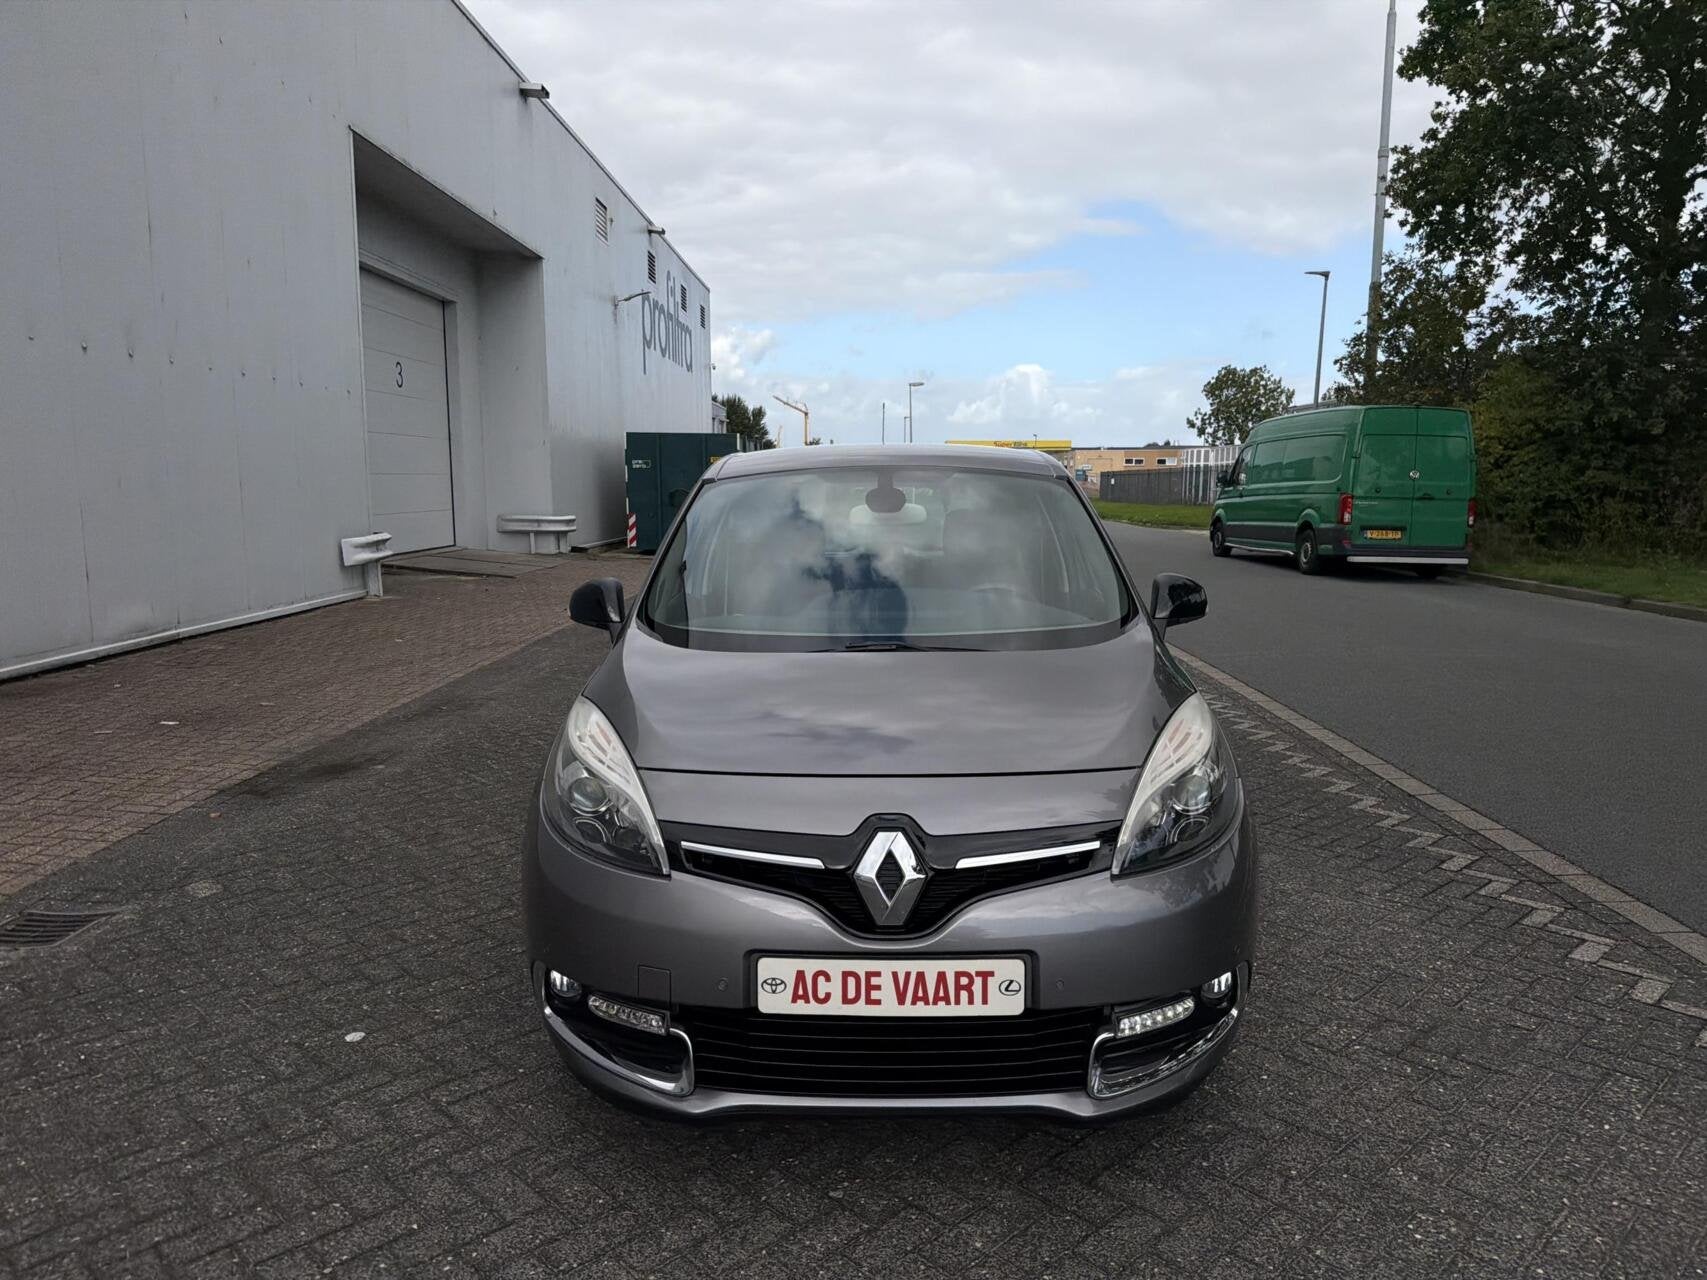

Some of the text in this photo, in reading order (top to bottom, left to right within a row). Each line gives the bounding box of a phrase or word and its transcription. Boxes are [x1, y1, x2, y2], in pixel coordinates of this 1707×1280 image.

[641, 270, 693, 375] profiltra
[395, 361, 403, 388] 3
[790, 969, 995, 1006] AC DE VAART
